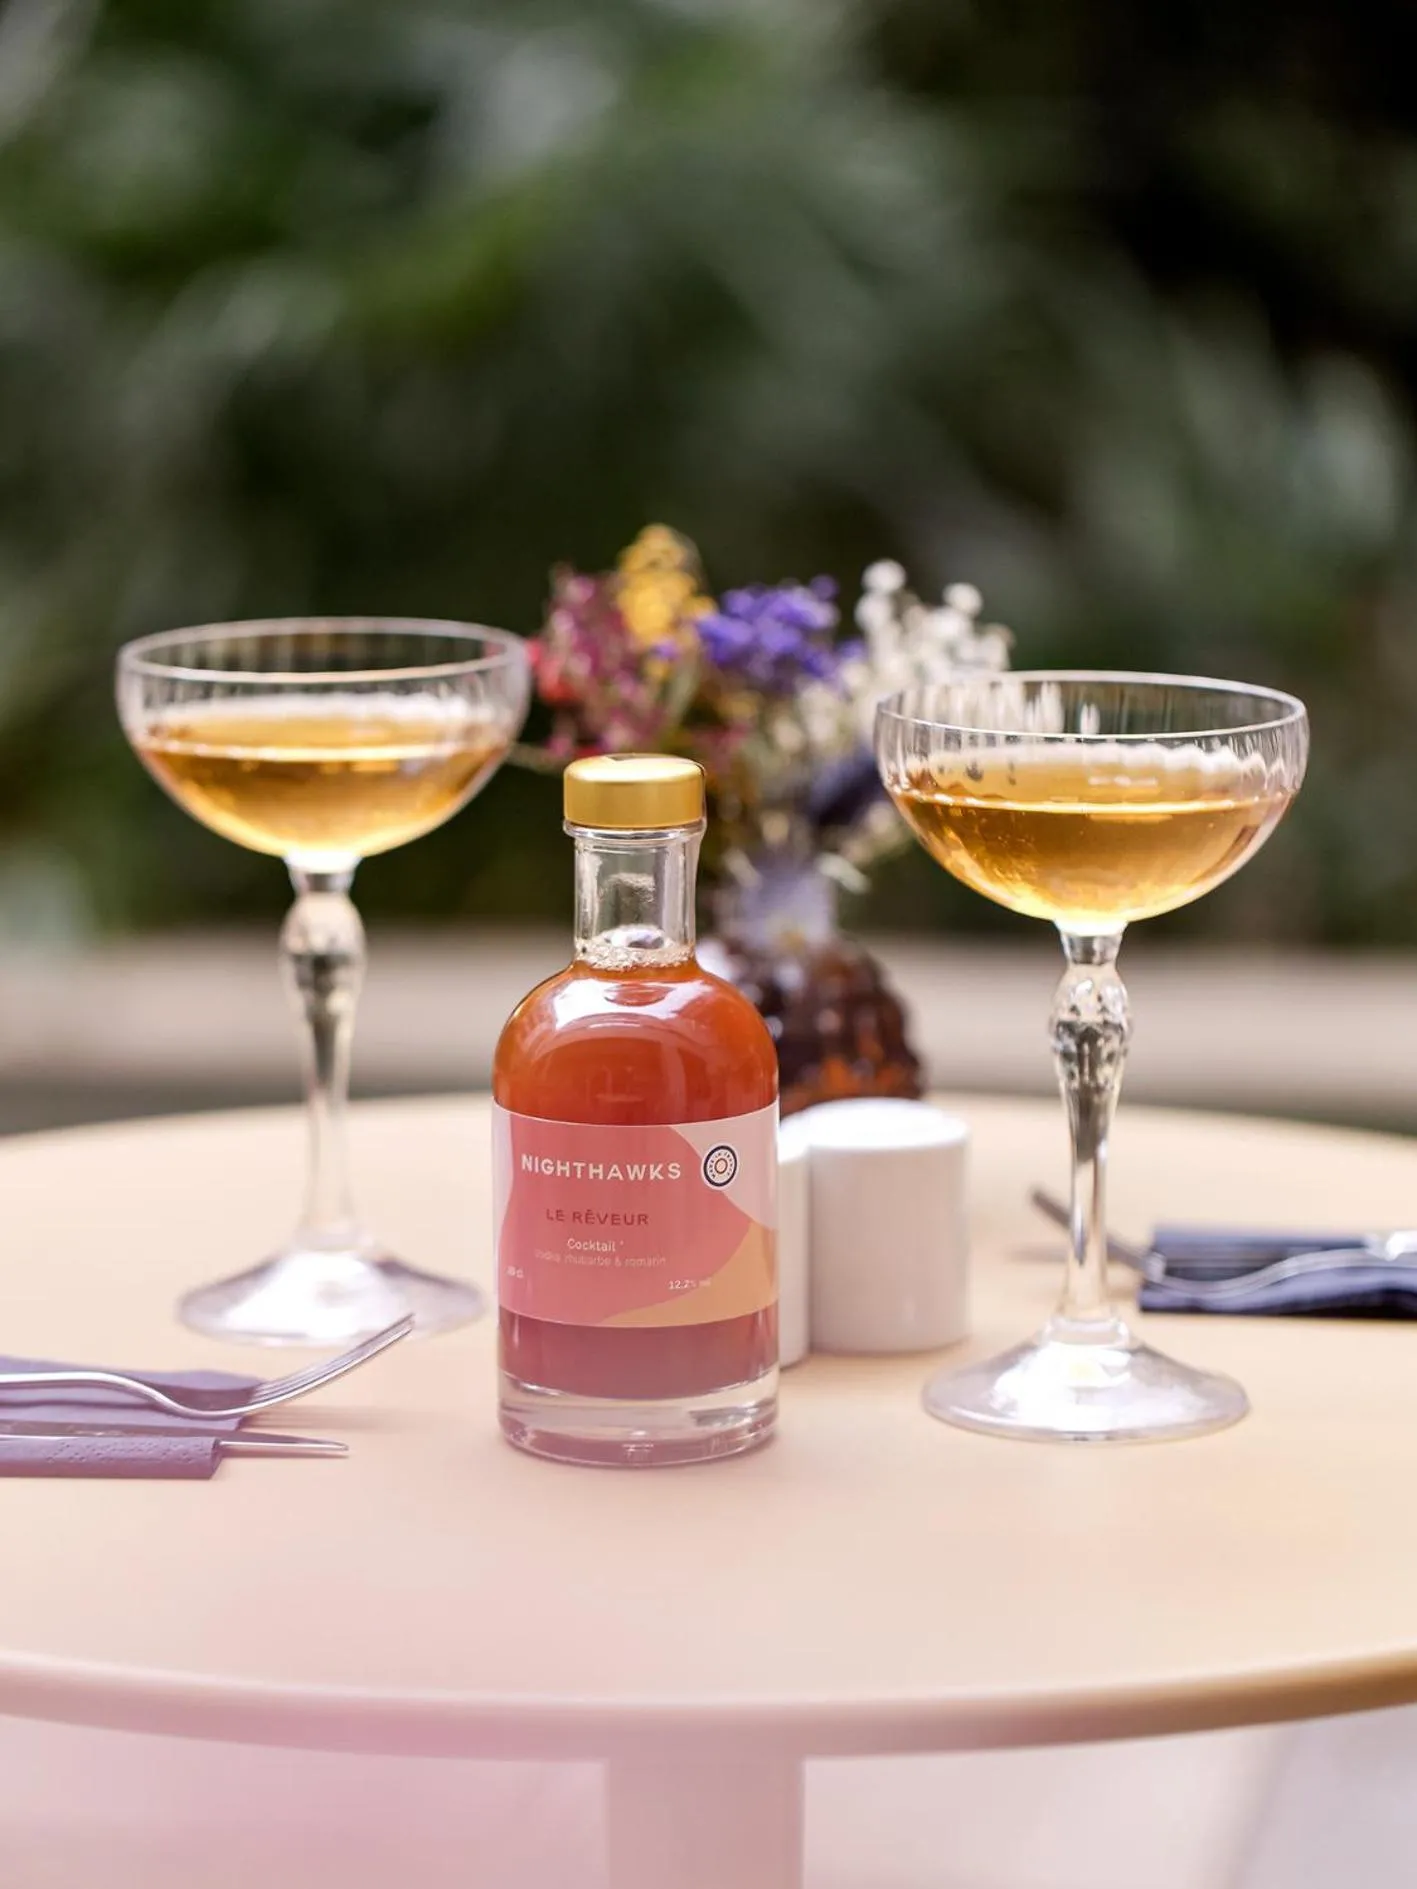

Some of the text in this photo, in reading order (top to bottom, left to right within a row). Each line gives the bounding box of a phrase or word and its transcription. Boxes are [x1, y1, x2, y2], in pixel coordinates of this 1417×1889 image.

[521, 1154, 681, 1181] NIGHTHAWKS
[546, 1208, 649, 1226] LE RÊVEUR
[567, 1237, 616, 1252] Cocktail
